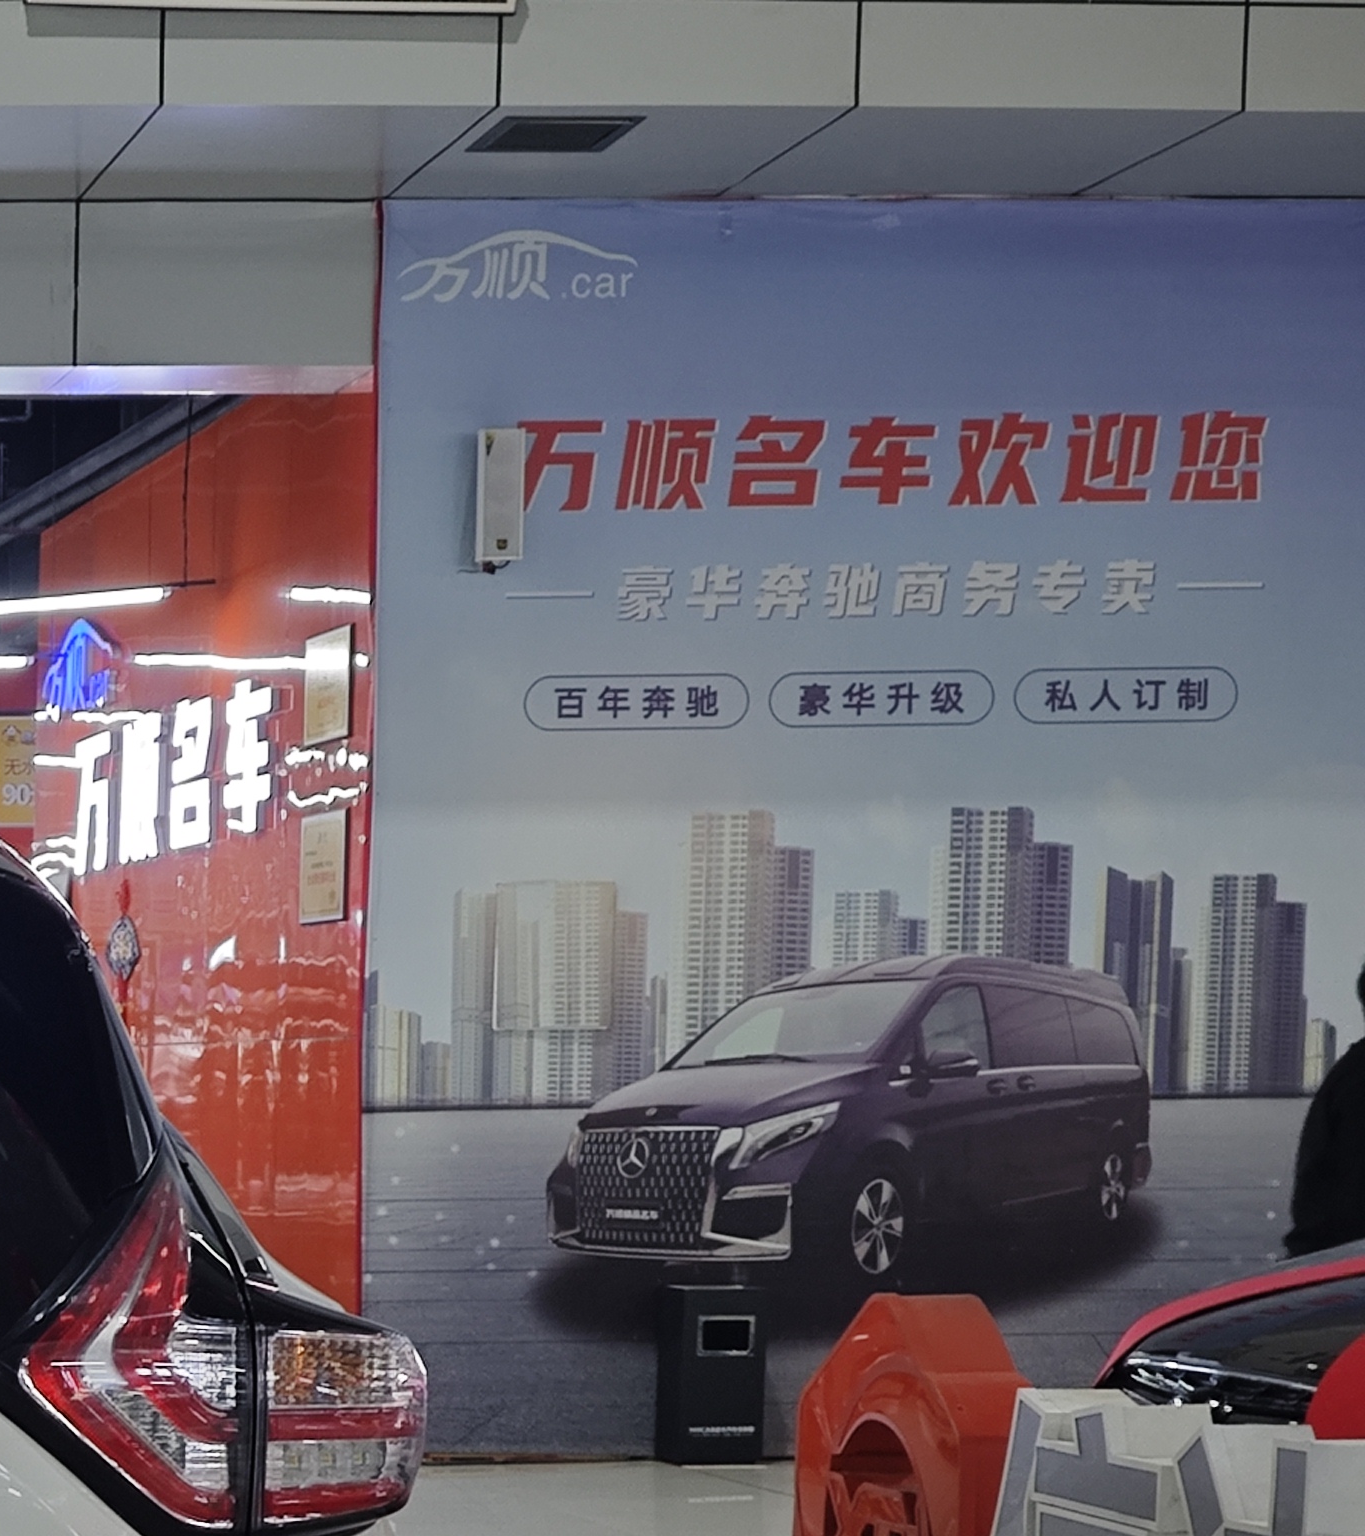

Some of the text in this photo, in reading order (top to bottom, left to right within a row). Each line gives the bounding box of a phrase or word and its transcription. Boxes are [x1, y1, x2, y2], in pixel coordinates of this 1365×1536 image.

[515, 409, 1269, 513] 万顺名车欢迎您
[614, 558, 1159, 624] 豪华奔驰商务专卖
[553, 681, 721, 721] 百年奔驰
[797, 679, 967, 718] 豪华升级
[1044, 677, 1212, 715] 私人订制
